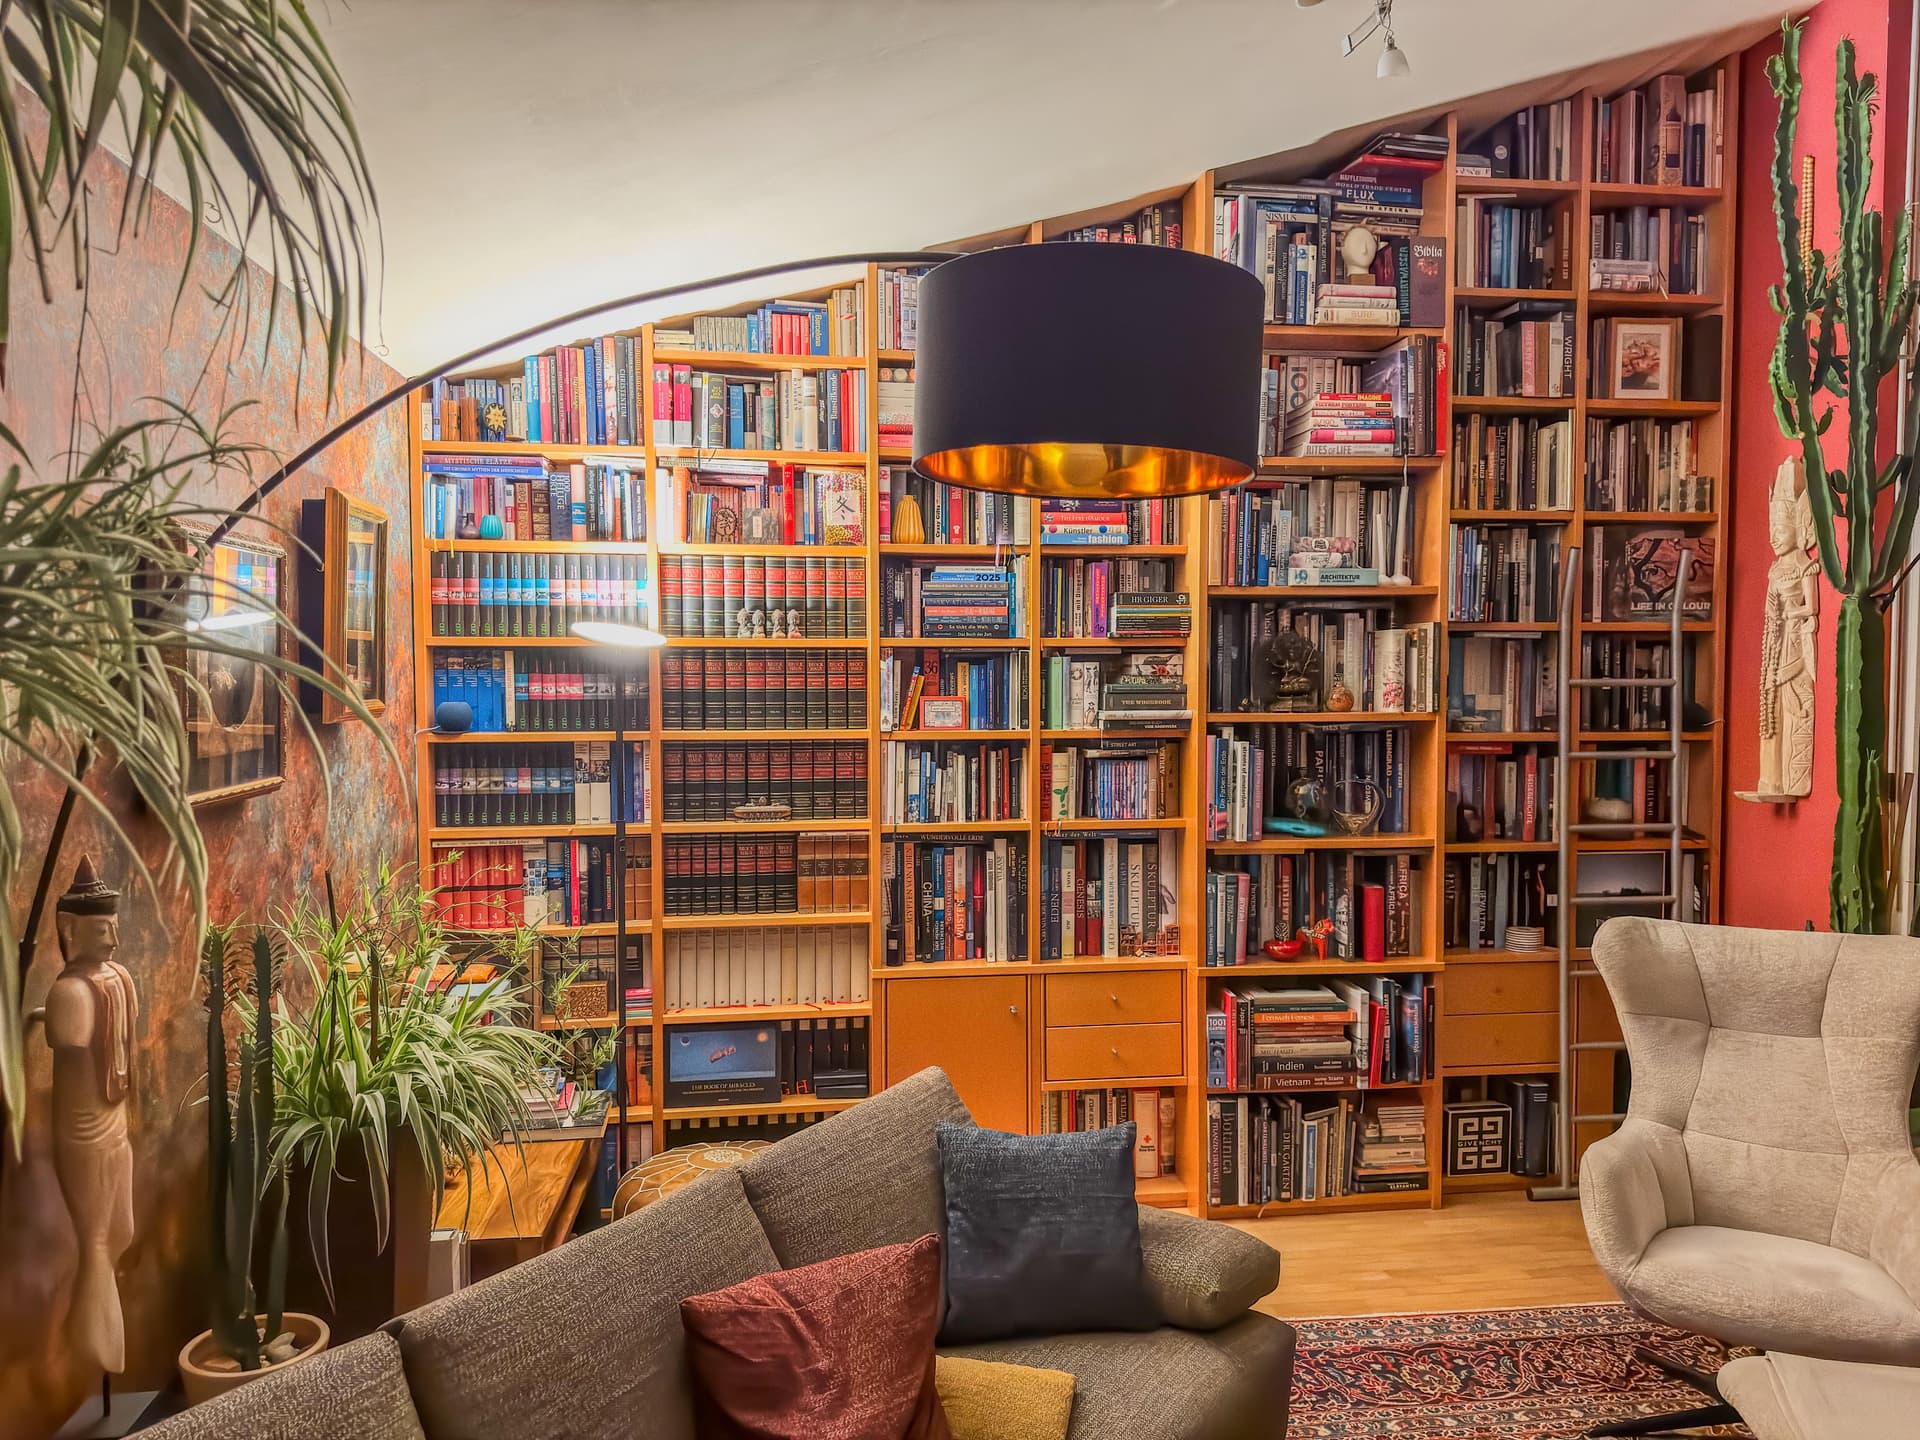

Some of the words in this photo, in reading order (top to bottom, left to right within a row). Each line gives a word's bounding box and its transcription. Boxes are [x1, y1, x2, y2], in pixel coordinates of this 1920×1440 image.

[1346, 189, 1375, 200] FLUX
[1413, 245, 1443, 257] Biblia
[1564, 335, 1573, 380] WRIGHT
[1306, 445, 1327, 455] RITES
[1336, 445, 1352, 455] LIFE
[1088, 534, 1123, 544] fashion
[1630, 601, 1653, 610] LIFE
[1655, 602, 1666, 610] IN
[1667, 602, 1712, 610] CLOUR
[925, 661, 938, 674] 36
[1398, 857, 1408, 899] AFRICA
[922, 881, 933, 917] CHINA
[1076, 878, 1085, 919] GENESIS
[1130, 863, 1141, 928] SKULPTUR
[1147, 863, 1157, 929] SKULPTUR
[1050, 893, 1059, 923] EDEN
[1209, 1018, 1226, 1026] 1001
[1276, 1062, 1305, 1071] Indien
[1275, 1078, 1311, 1087] Vietnam
[1222, 1112, 1235, 1175] Botanica
[1282, 1132, 1291, 1152] DER
[1457, 1139, 1502, 1147] GIVENCHY
[1282, 1153, 1291, 1190] GARTEN
